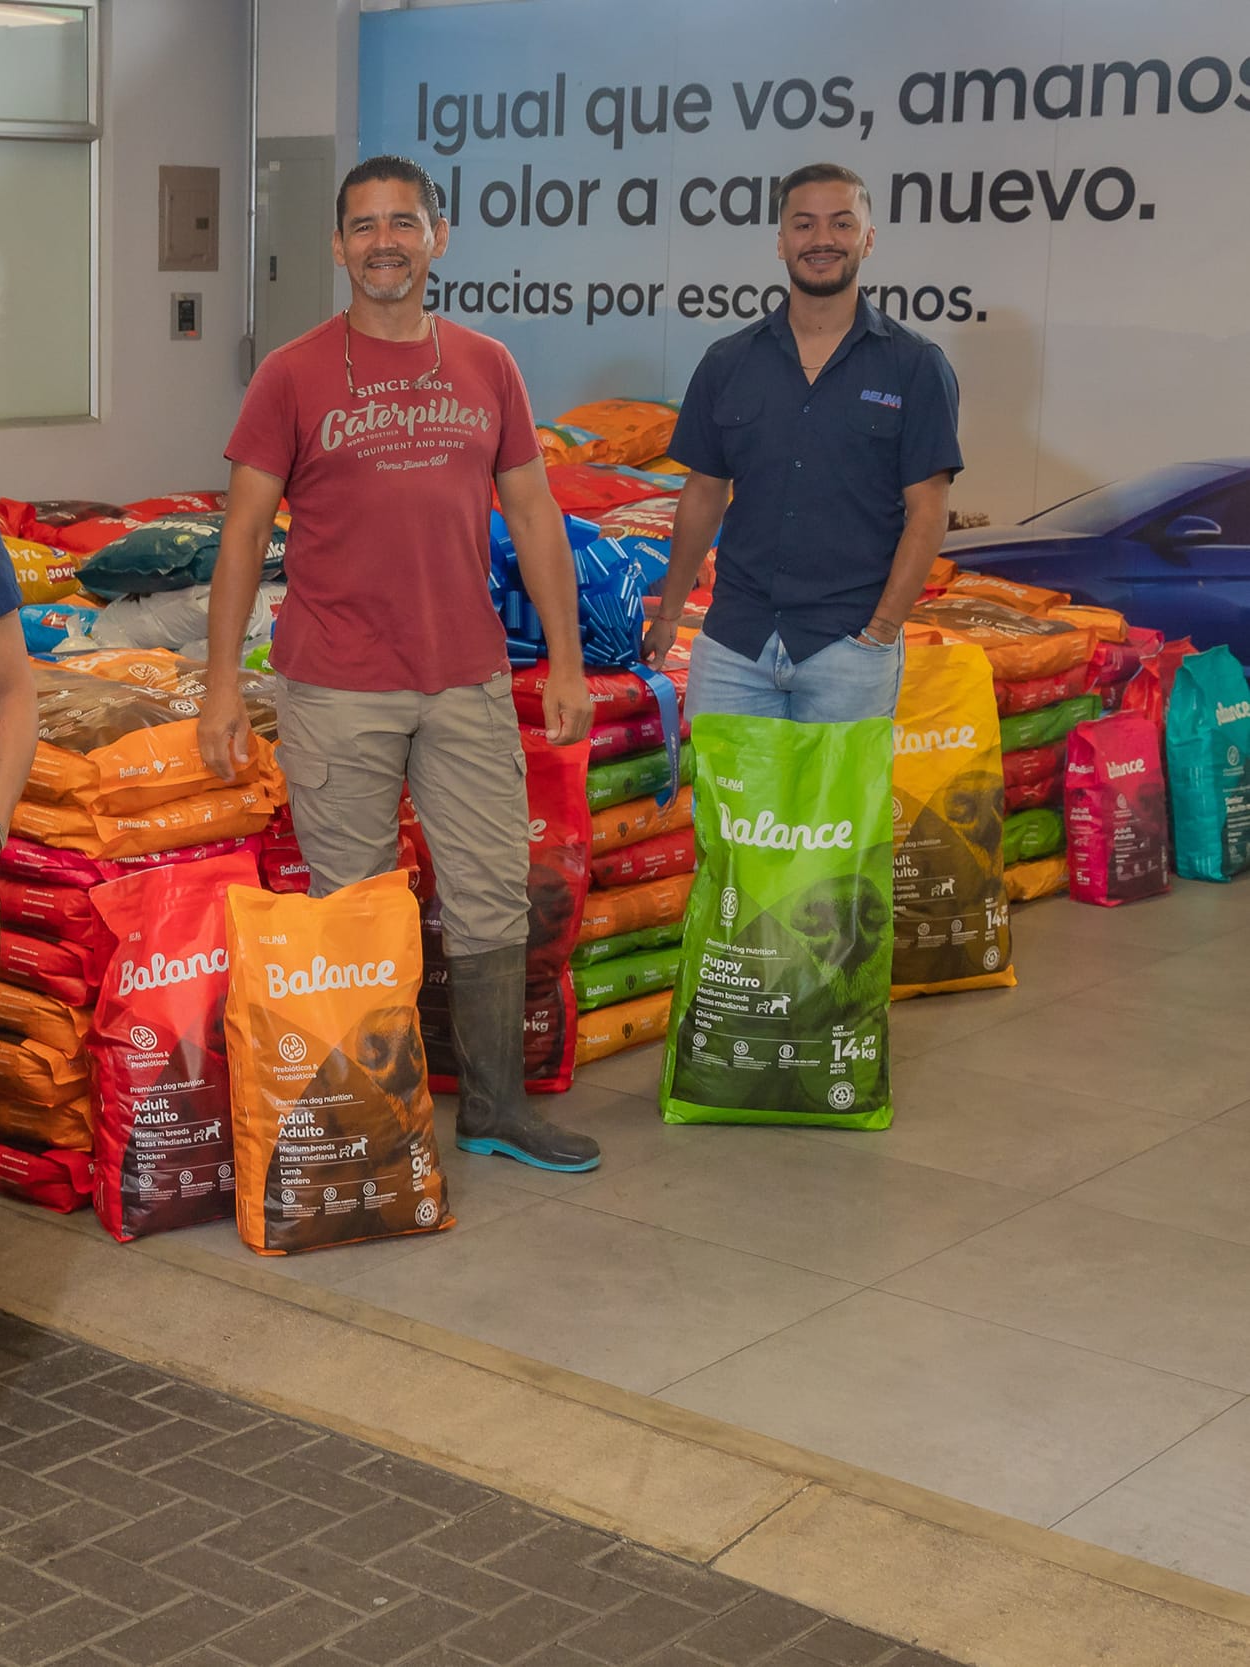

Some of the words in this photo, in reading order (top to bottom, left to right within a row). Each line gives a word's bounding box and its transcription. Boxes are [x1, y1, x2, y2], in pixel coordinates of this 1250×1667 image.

[418, 73, 566, 155] Igual
[586, 83, 712, 150] que
[732, 76, 874, 141] vos,
[479, 164, 600, 228] olor
[617, 177, 658, 227] a
[889, 166, 1156, 224] nuevo.
[587, 282, 665, 326] por
[356, 379, 410, 398] SINCE
[413, 380, 454, 393] 904
[320, 396, 491, 452] Caterpillar
[346, 436, 366, 448] WORK
[366, 429, 399, 441] TOGETHER
[357, 441, 413, 459] EQUIPMENT
[415, 440, 435, 449] AND
[438, 439, 466, 450] MORE
[430, 453, 449, 467] USA
[893, 724, 978, 756] lance
[119, 765, 150, 778] Balance
[280, 863, 311, 877] Balance
[731, 945, 745, 955] dog
[745, 946, 777, 956] nutrition
[701, 952, 743, 975] Puppy
[118, 947, 230, 997] Balanc
[264, 955, 398, 1000] Balance
[699, 966, 761, 989] Cachorro
[586, 983, 615, 998] Balance
[697, 985, 725, 999] Medium
[724, 991, 750, 1003] breeds
[714, 999, 750, 1012] medianas
[695, 1009, 724, 1022] Chicken
[532, 1020, 549, 1033] kg
[694, 1018, 712, 1030] Pollo
[832, 1030, 855, 1038] WEIGHT
[831, 1037, 860, 1062] 14
[861, 1046, 877, 1061] kg
[131, 1058, 170, 1069] Probióticos
[272, 1063, 312, 1073] Prebióticos
[276, 1070, 317, 1081] Probióticos
[130, 1085, 163, 1094] Premium
[162, 1082, 177, 1091] dog
[177, 1078, 206, 1089] nutrition
[132, 1097, 170, 1112] Adult
[275, 1098, 309, 1106] Premium
[309, 1096, 324, 1105] dog
[324, 1093, 354, 1103] nutrition
[134, 1111, 179, 1125] Adulto
[277, 1111, 316, 1125] Adult
[134, 1130, 165, 1139] Medium
[165, 1127, 190, 1137] breeds
[278, 1125, 325, 1138] Adulto
[135, 1140, 157, 1148] Razas
[157, 1137, 192, 1147] medianas
[278, 1145, 309, 1153] Medium
[310, 1143, 336, 1152] breeds
[136, 1152, 167, 1161] Chicken
[279, 1155, 301, 1163] Razas
[301, 1152, 338, 1161] medianas
[137, 1162, 157, 1170] Pollo
[280, 1168, 302, 1176] Lamb
[411, 1156, 423, 1179] 9
[280, 1177, 311, 1185] Cordero
